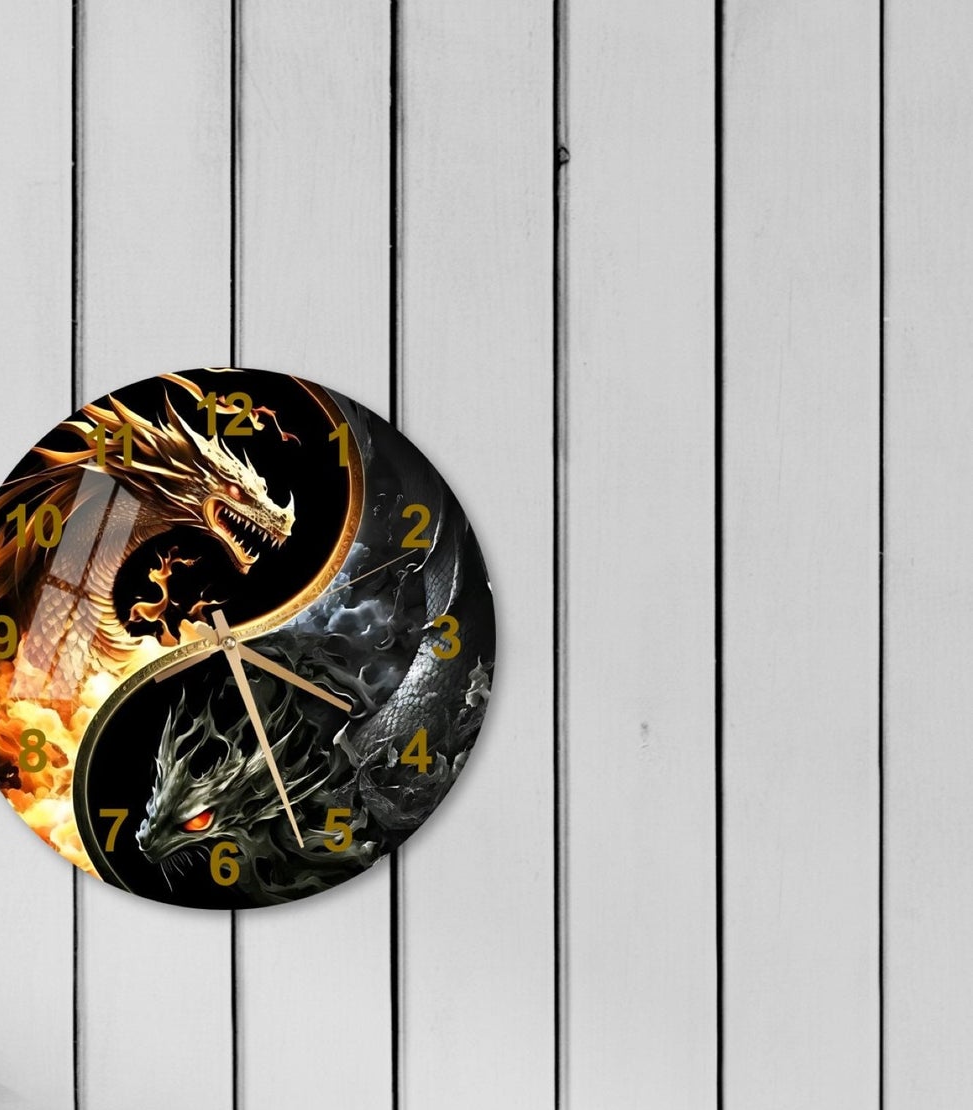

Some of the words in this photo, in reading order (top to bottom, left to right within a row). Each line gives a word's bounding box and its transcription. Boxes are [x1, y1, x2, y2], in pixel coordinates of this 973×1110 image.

[196, 392, 254, 436] 12
[87, 423, 133, 467] 11
[329, 423, 350, 467] 1
[6, 504, 63, 549] 10
[400, 504, 432, 549] 2
[432, 615, 461, 660] 3
[18, 729, 47, 773] 8
[399, 729, 433, 773] 4
[99, 809, 129, 852] 7
[324, 809, 353, 853] 5
[209, 843, 240, 887] 6
